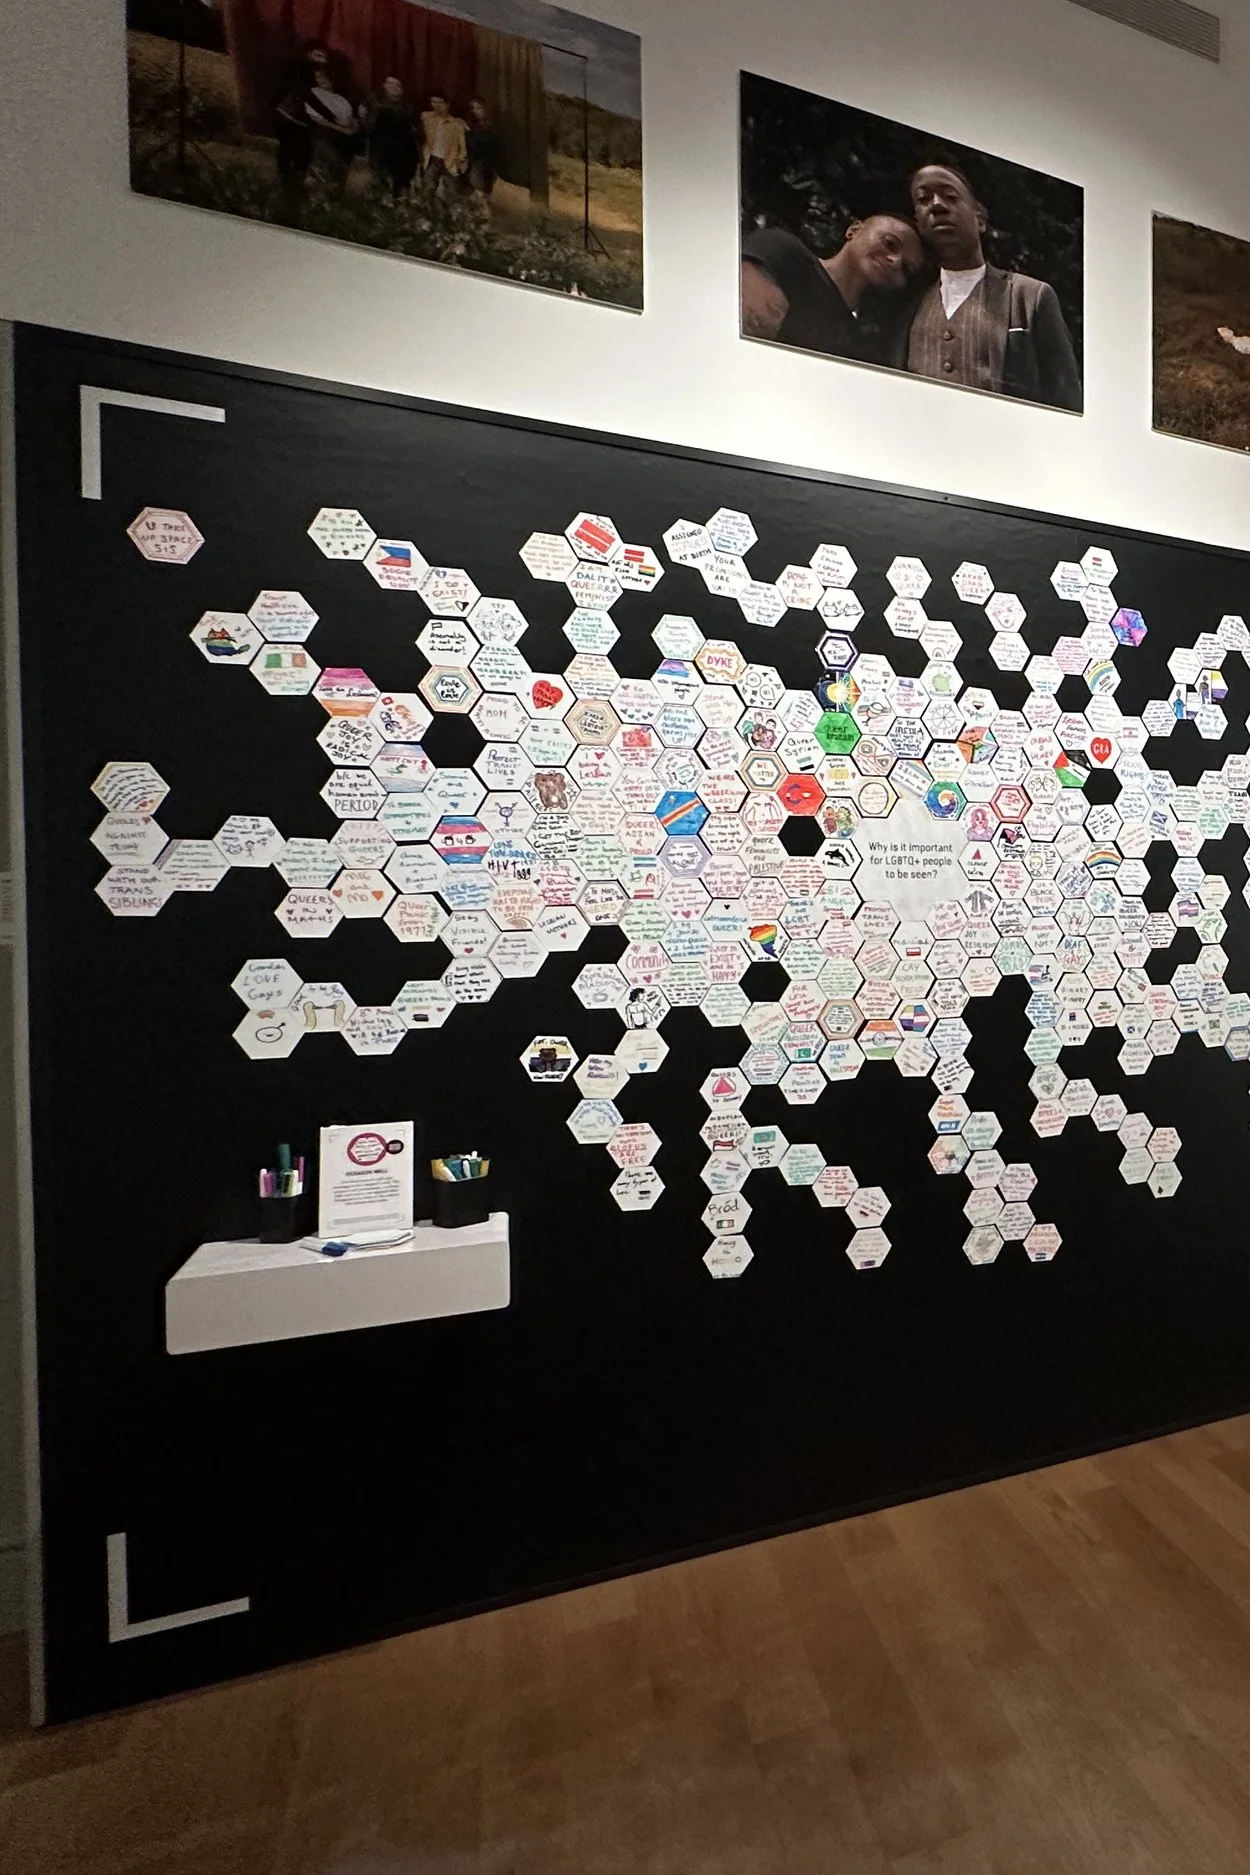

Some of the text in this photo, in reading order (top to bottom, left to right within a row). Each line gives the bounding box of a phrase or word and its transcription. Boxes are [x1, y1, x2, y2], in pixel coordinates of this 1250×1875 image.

[707, 655, 733, 669] DYKE
[338, 719, 373, 742] QUEER
[334, 800, 378, 813] PERIOD
[869, 842, 887, 853] Why
[909, 843, 952, 853] important
[870, 856, 952, 866] for LGBTQ+ people
[911, 870, 937, 878] seen?
